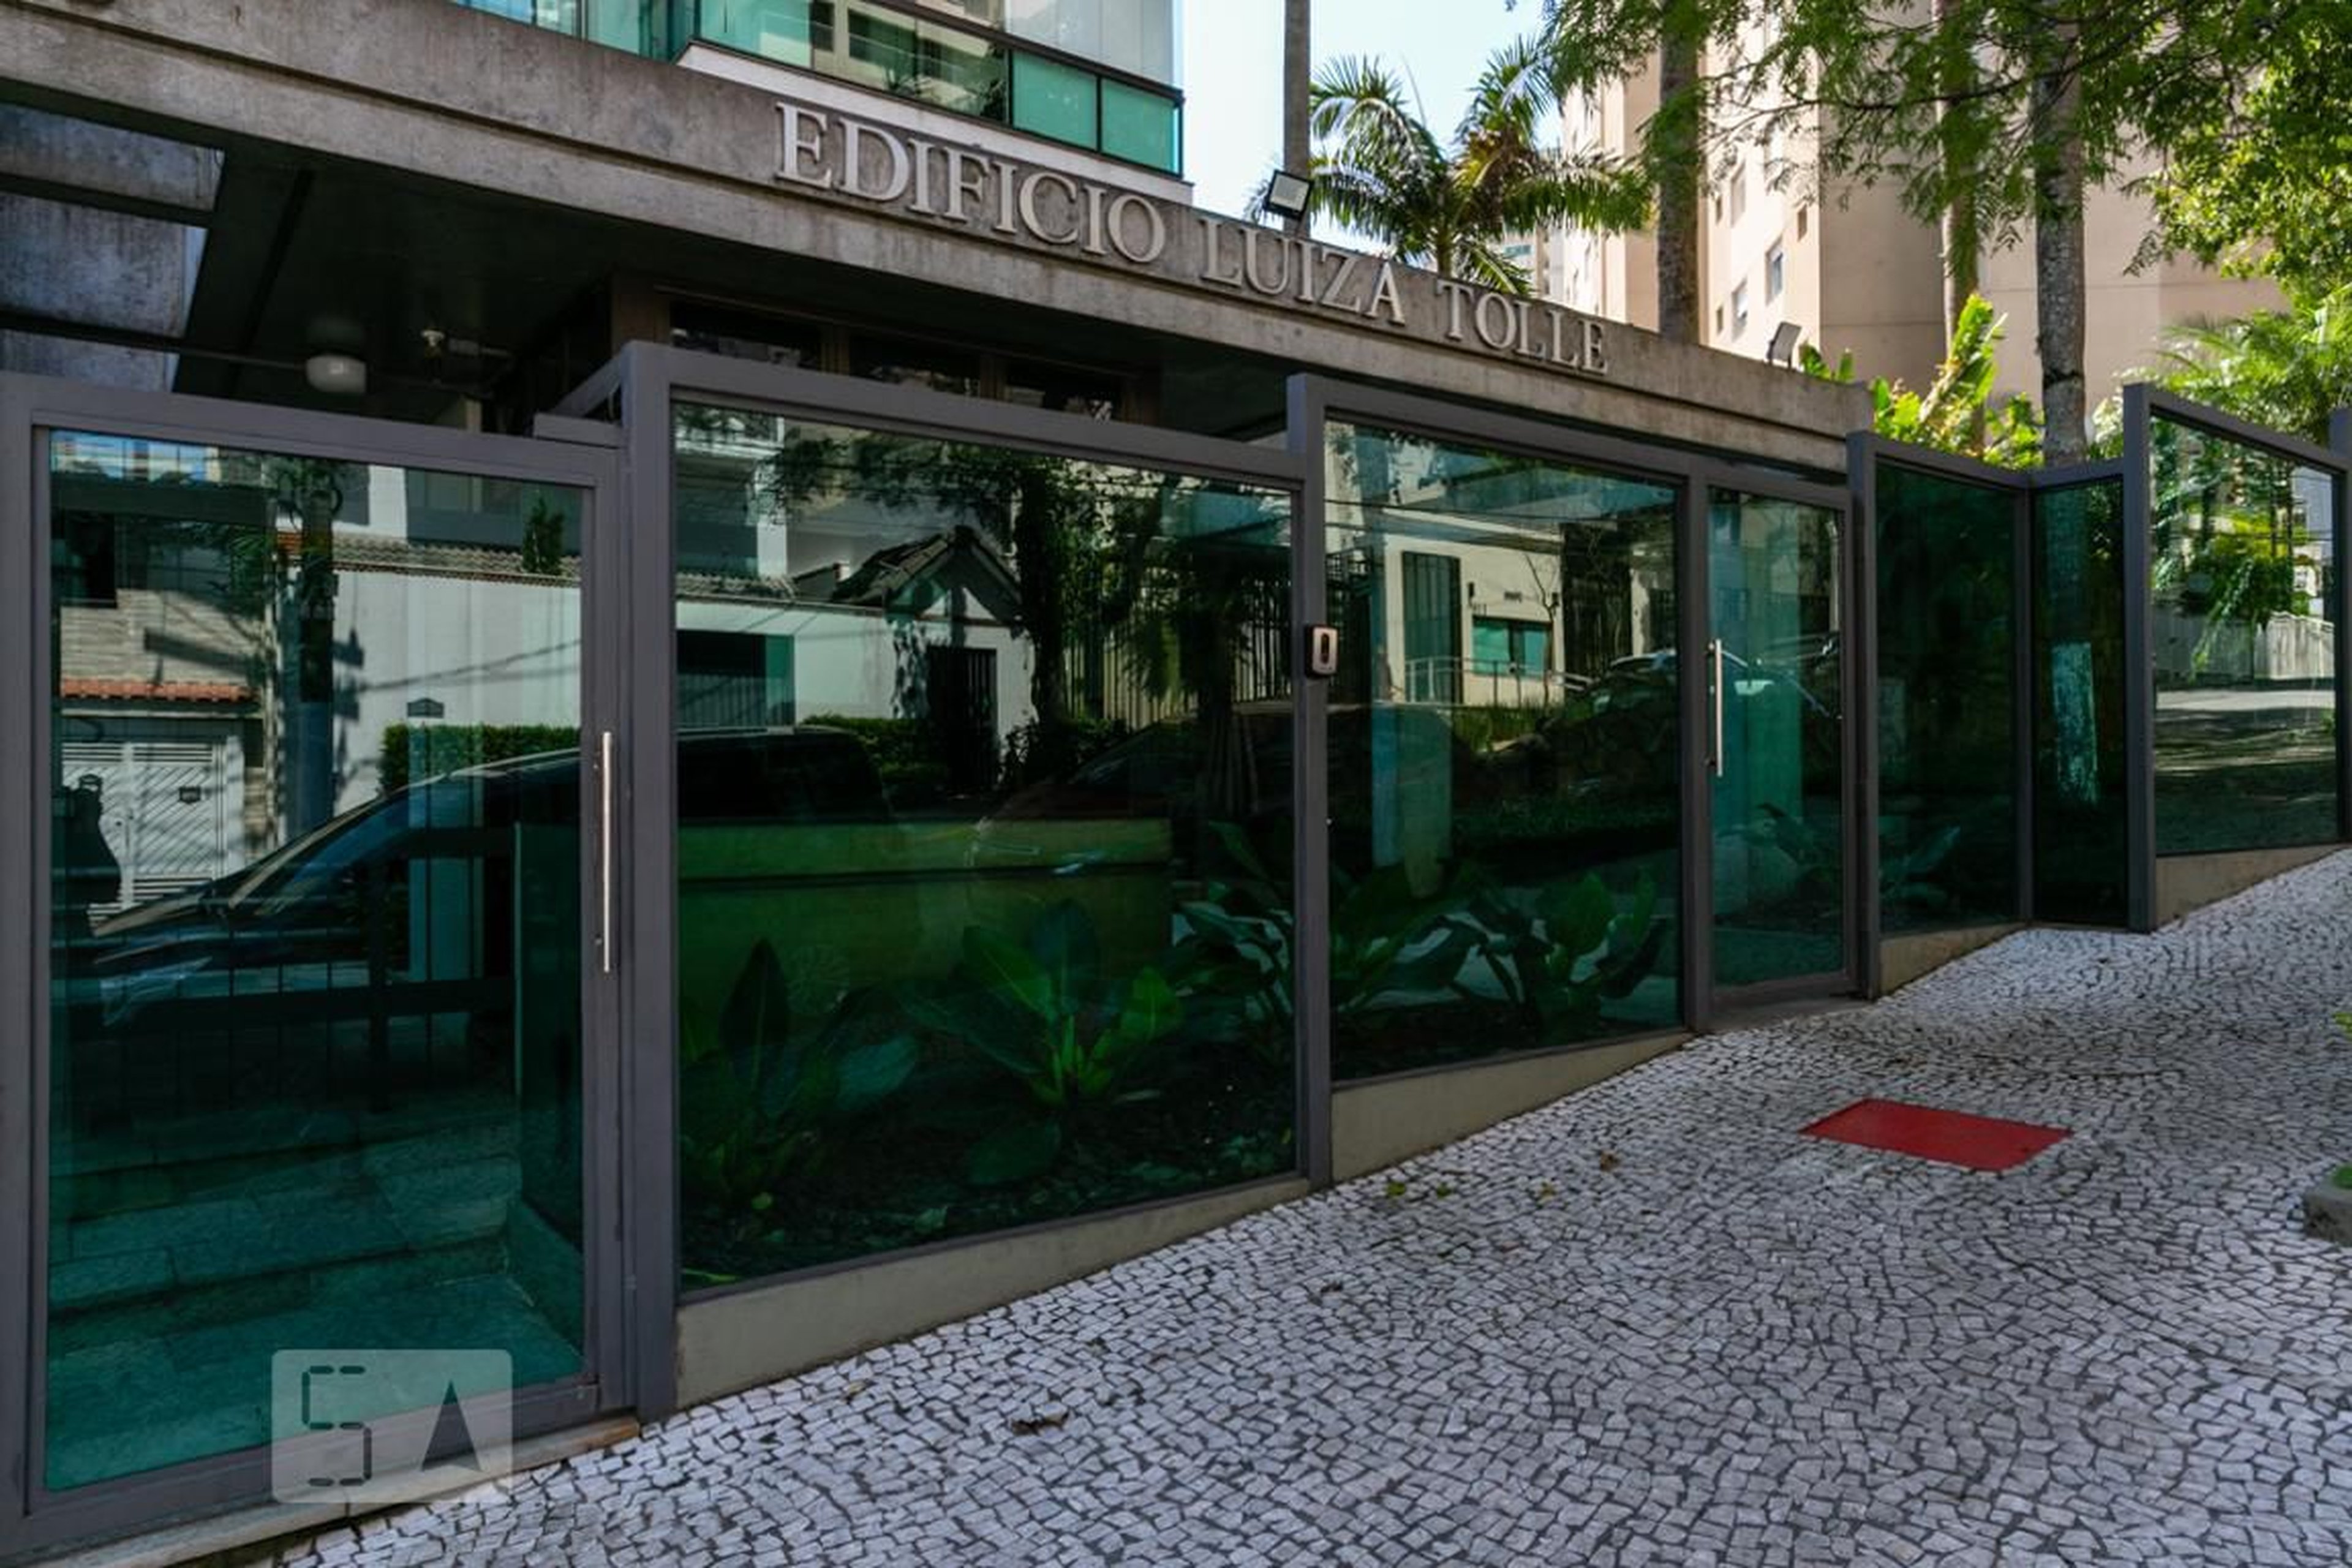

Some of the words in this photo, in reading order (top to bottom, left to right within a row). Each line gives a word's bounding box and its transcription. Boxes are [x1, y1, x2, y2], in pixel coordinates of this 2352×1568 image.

[775, 102, 1164, 263] EDIFICIO
[1198, 218, 1406, 326] LUIZA
[1437, 279, 1608, 374] TOLLE
